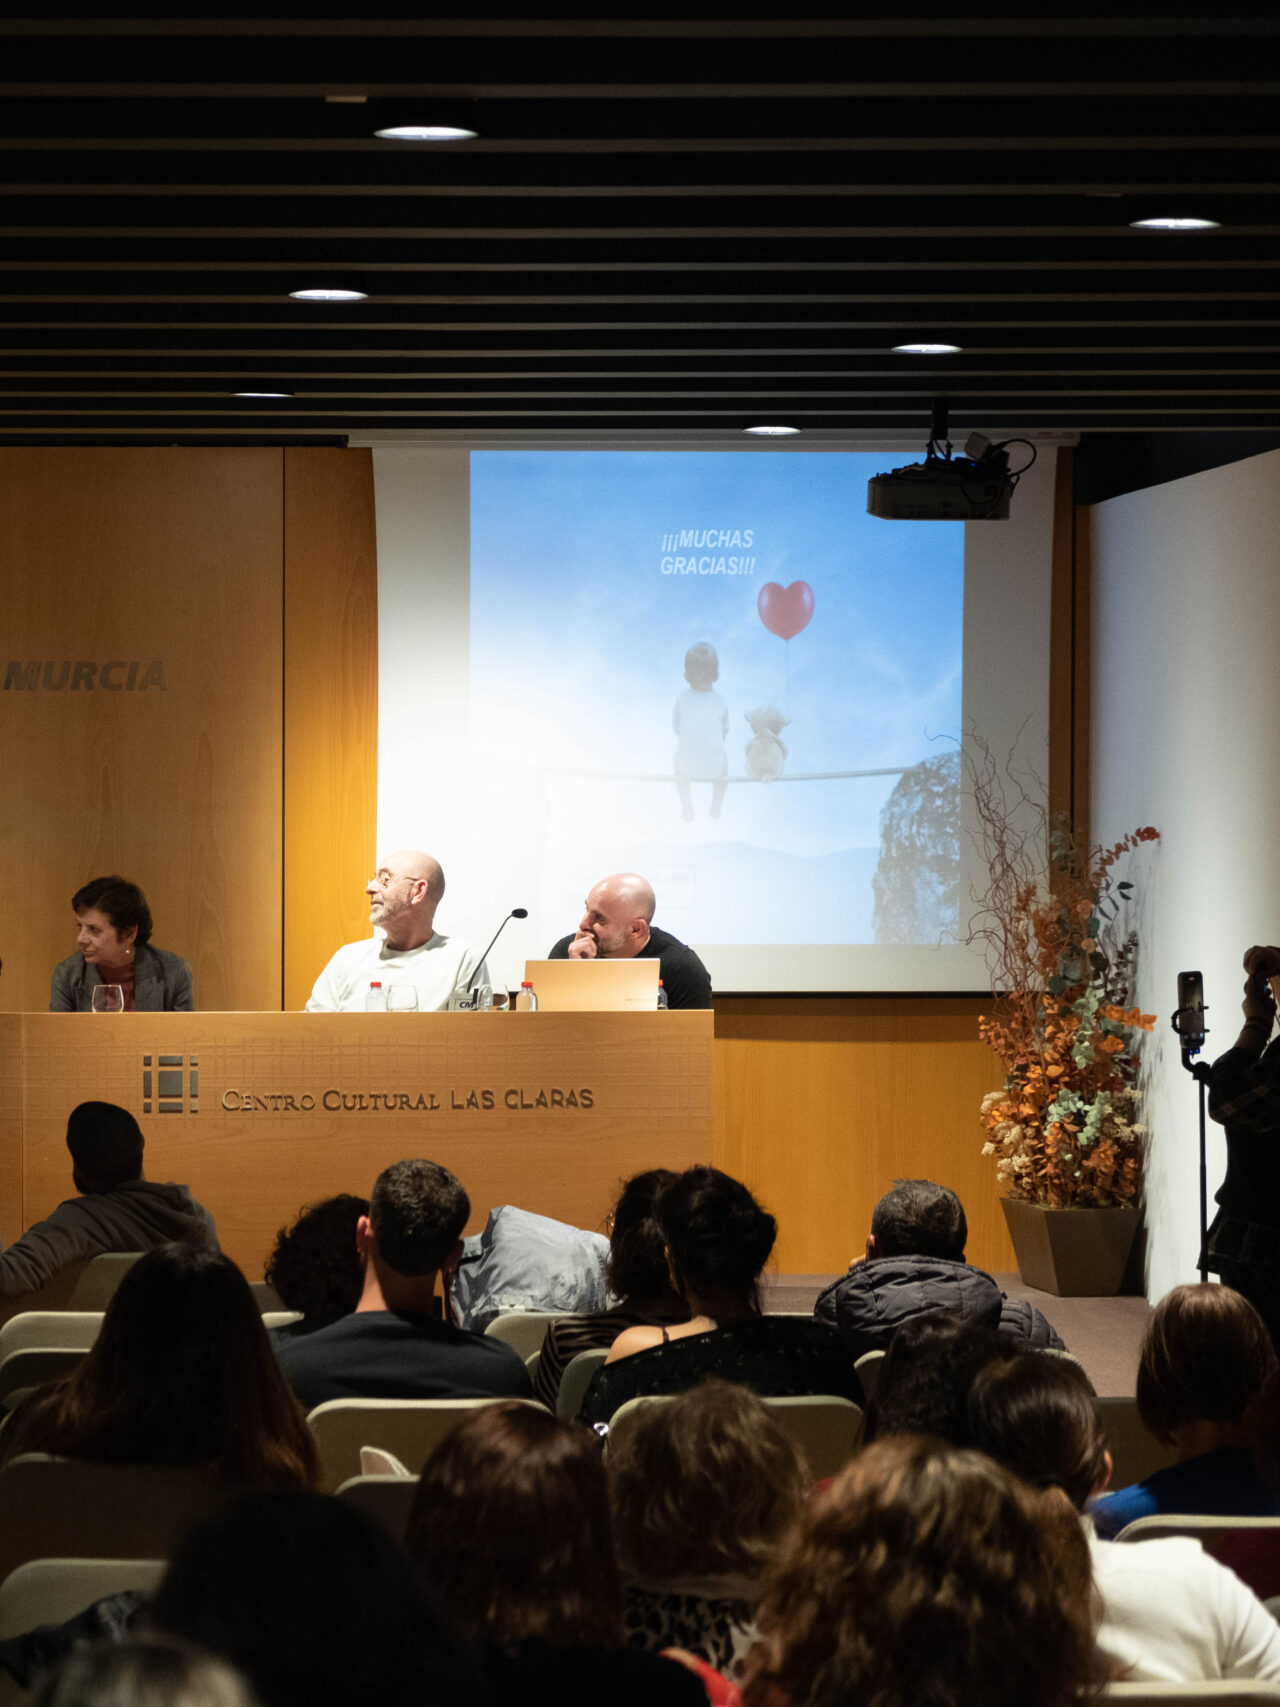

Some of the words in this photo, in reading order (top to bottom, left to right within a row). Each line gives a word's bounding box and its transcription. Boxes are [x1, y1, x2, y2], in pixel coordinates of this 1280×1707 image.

[661, 529, 754, 552] ¡¡¡MUCHAS
[660, 556, 756, 575] GRACIAS!!!
[451, 1089, 495, 1110] LAS
[504, 1088, 594, 1110] CLARAS
